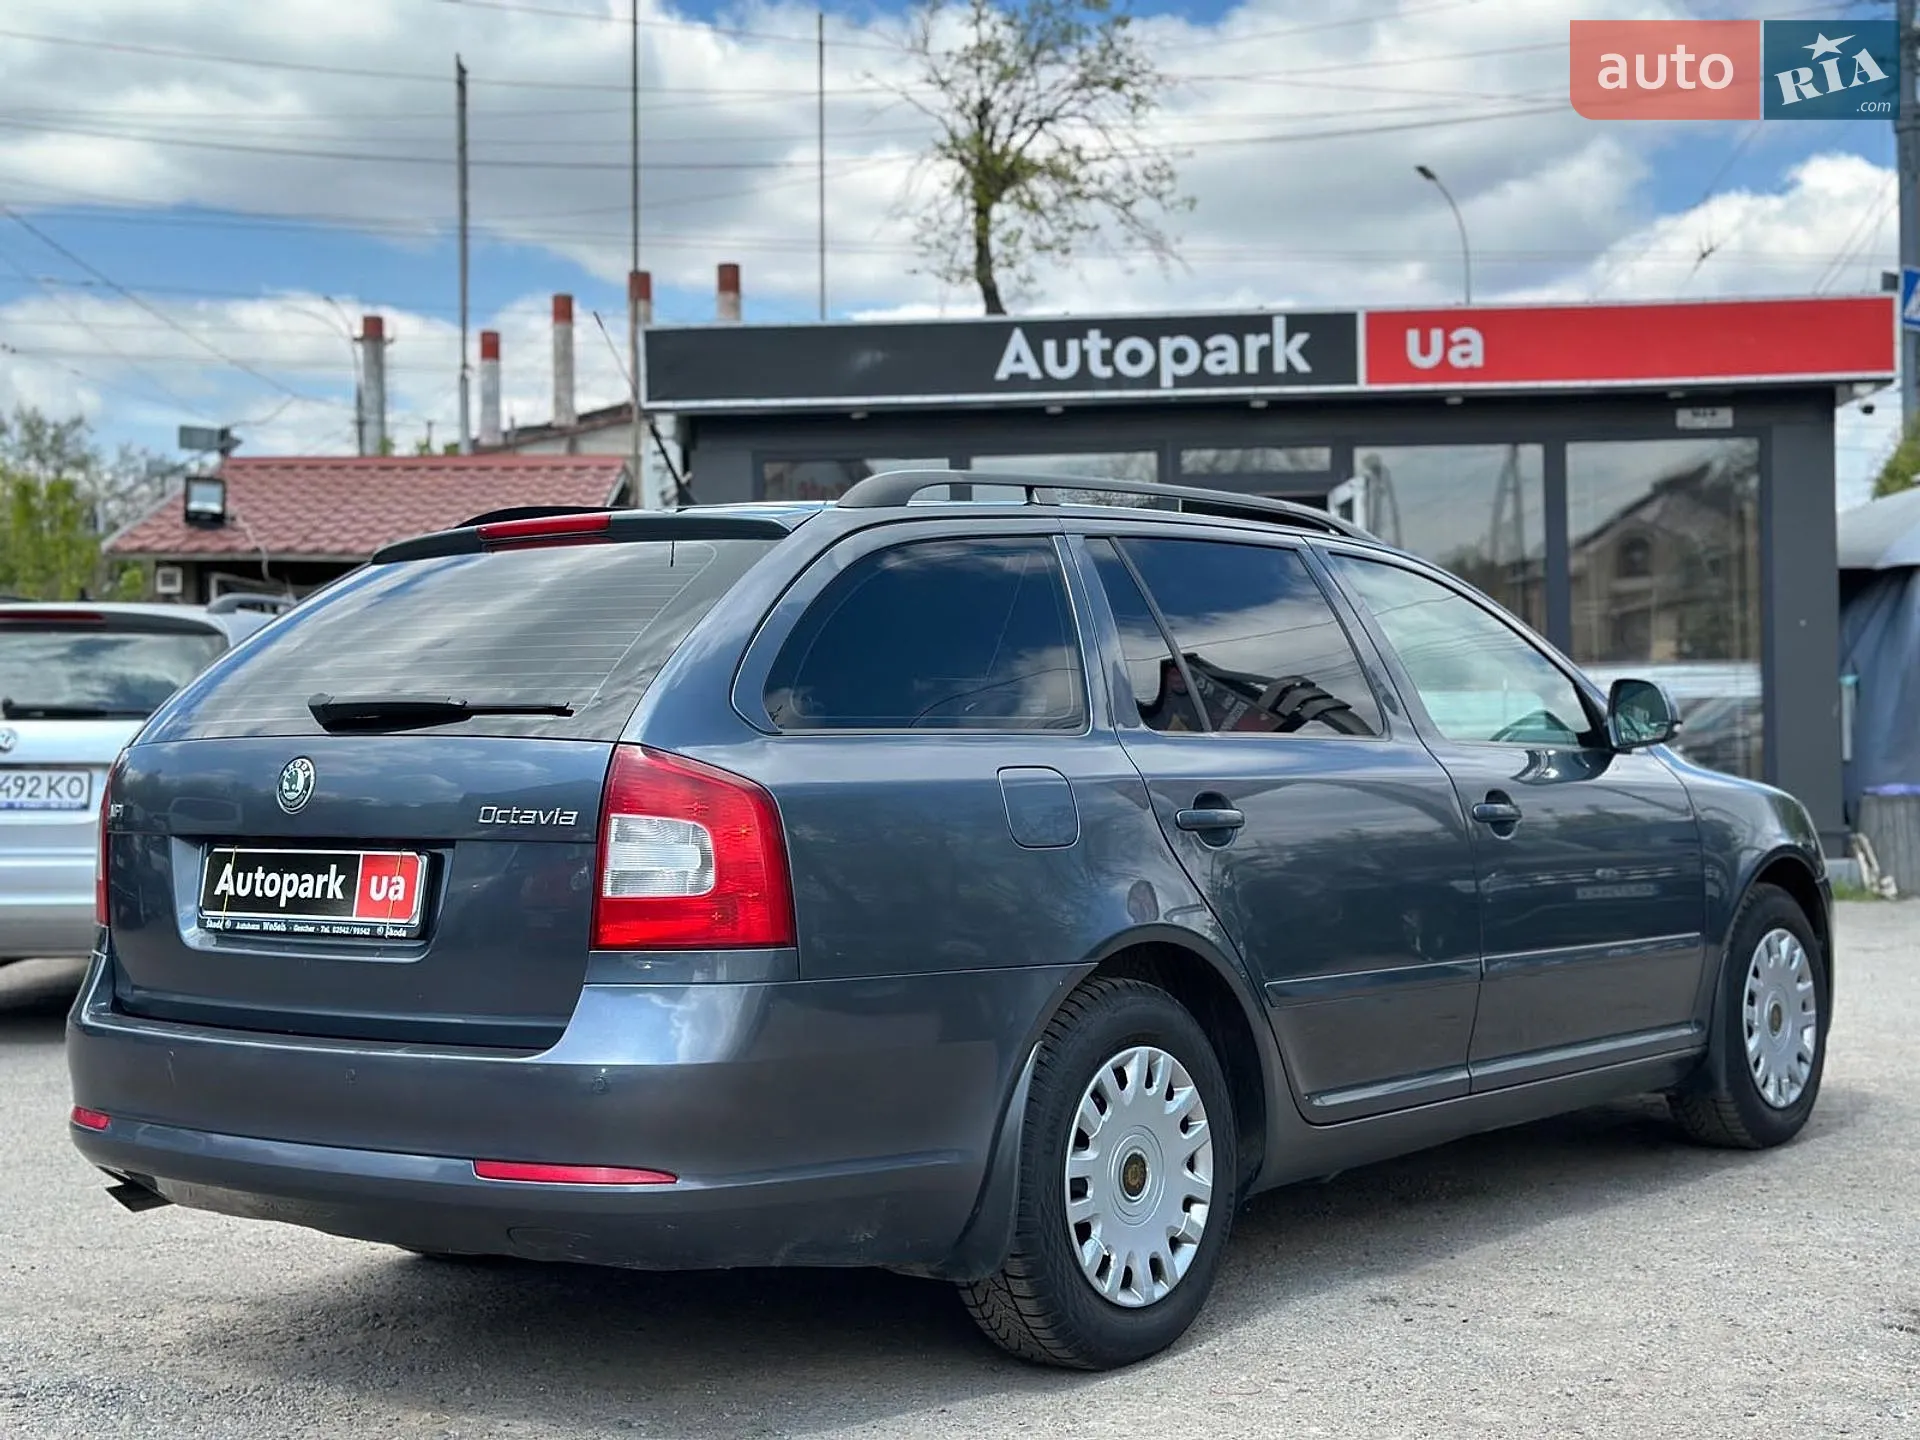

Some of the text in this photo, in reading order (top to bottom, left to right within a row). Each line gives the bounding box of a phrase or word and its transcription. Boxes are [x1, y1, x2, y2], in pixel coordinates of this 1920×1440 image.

[994, 315, 1485, 388] Autopark ua
[478, 806, 579, 825] Octavia
[214, 862, 406, 907] Autopark ua
